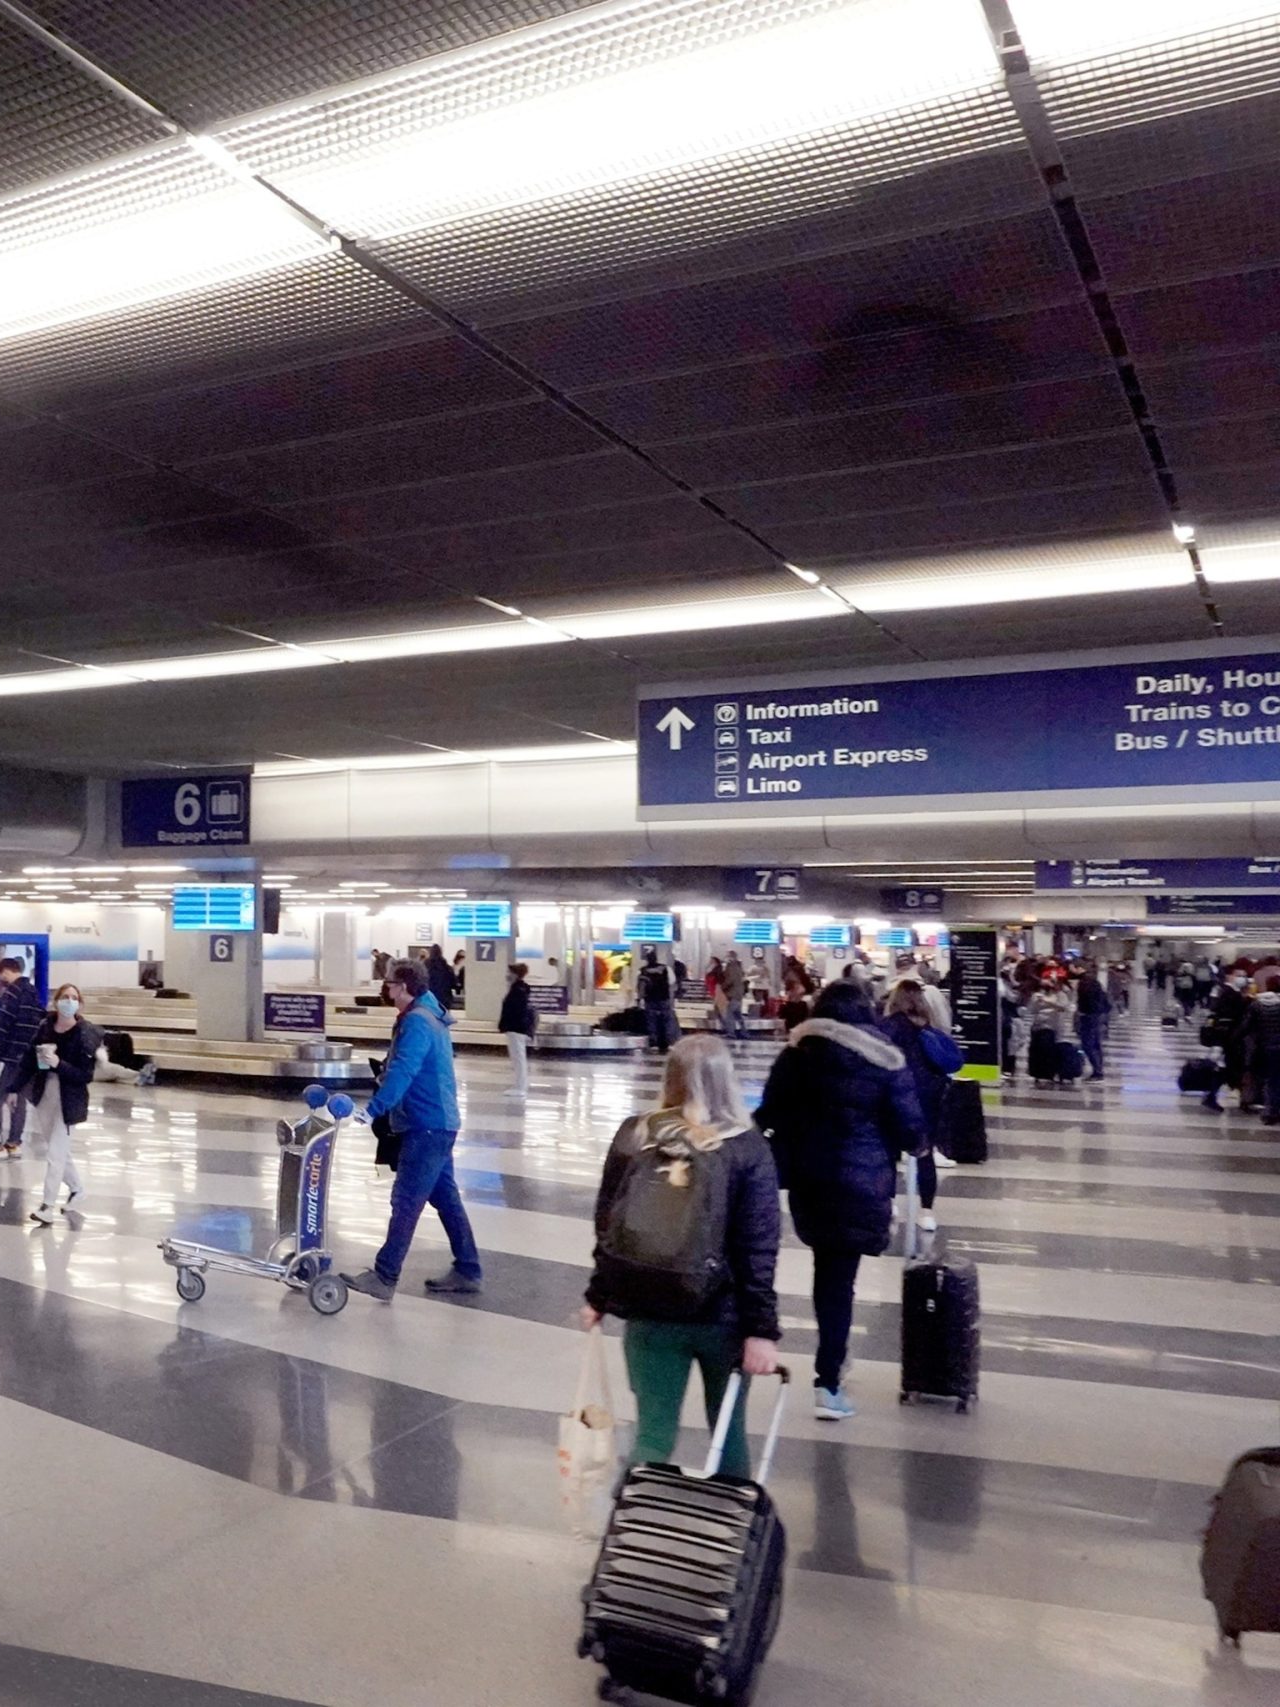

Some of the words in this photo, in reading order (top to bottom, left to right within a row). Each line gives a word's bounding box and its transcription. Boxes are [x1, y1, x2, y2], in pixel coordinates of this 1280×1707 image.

[1136, 673, 1214, 695] Daily,
[746, 698, 879, 720] Information
[1124, 702, 1212, 722] Trains
[1220, 700, 1251, 717] to
[747, 727, 792, 744] Taxi
[1115, 733, 1169, 751] Bus
[1176, 729, 1189, 748] /
[748, 750, 827, 771] Airport
[833, 748, 928, 767] Express
[746, 777, 802, 794] Limo
[174, 782, 201, 825] 6
[157, 831, 207, 843] Baggage
[209, 829, 243, 840] Claim
[755, 870, 771, 892] 7
[1086, 867, 1149, 875] Information
[1086, 878, 1125, 886] Airport
[905, 890, 919, 906] 8
[214, 938, 229, 958] 6
[479, 943, 491, 959] 7
[307, 1152, 323, 1236] smartecarte
